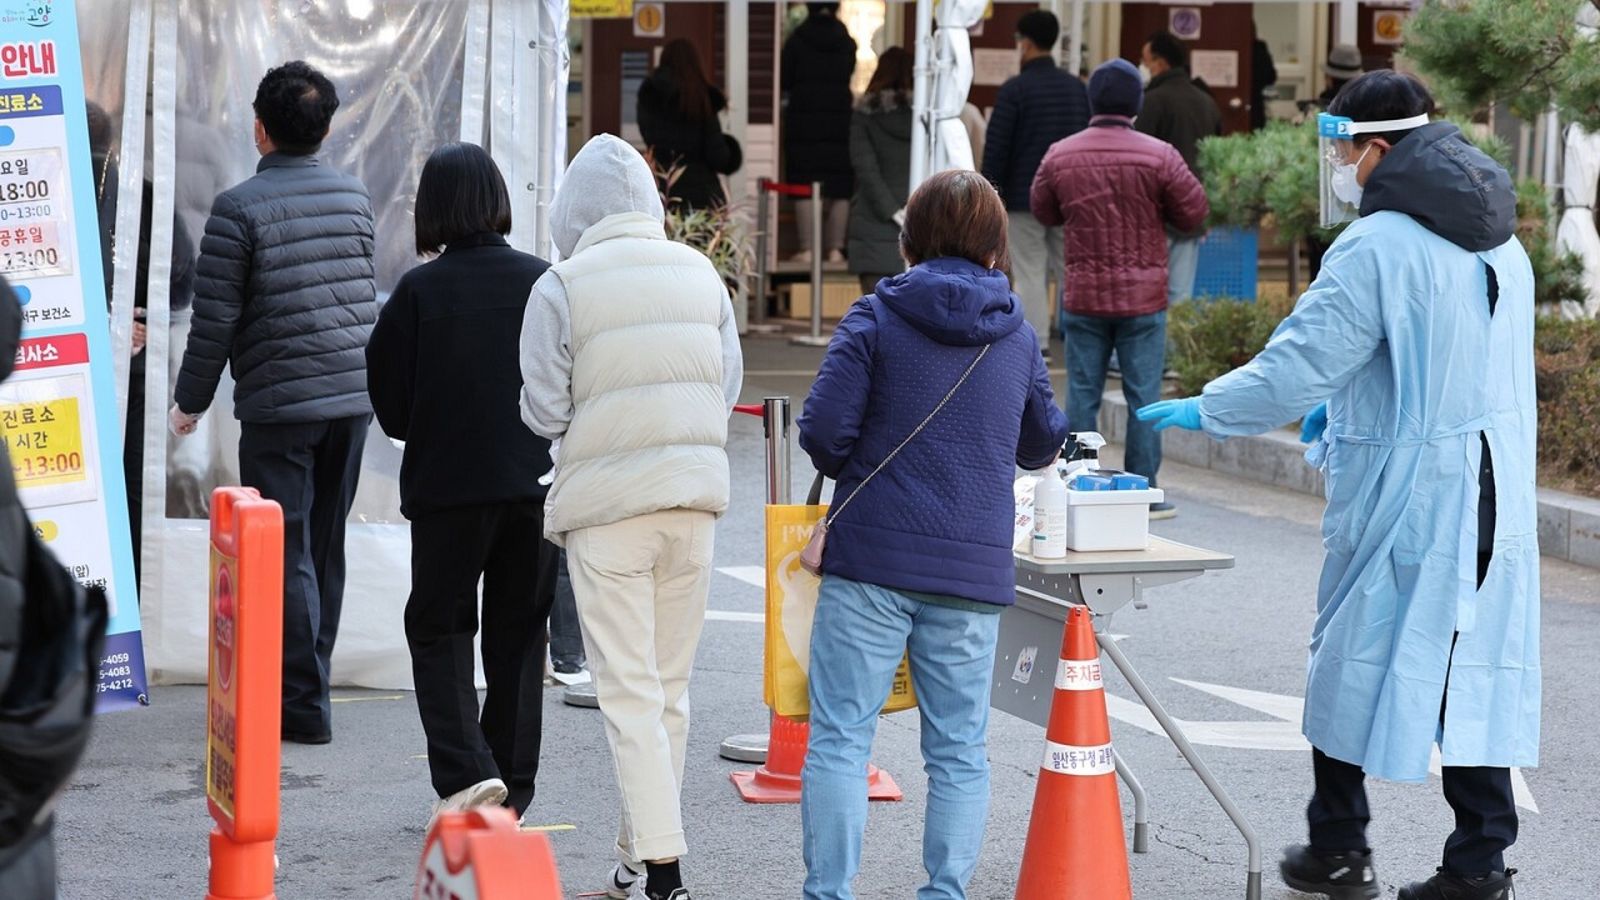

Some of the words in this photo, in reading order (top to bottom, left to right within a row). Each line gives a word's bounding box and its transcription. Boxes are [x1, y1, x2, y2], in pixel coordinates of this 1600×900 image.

[2, 42, 56, 77] 안내
[0, 227, 43, 247] 공휴일
[42, 307, 71, 321] 보건소
[3, 406, 55, 429] 진료소
[17, 431, 48, 449] 시간
